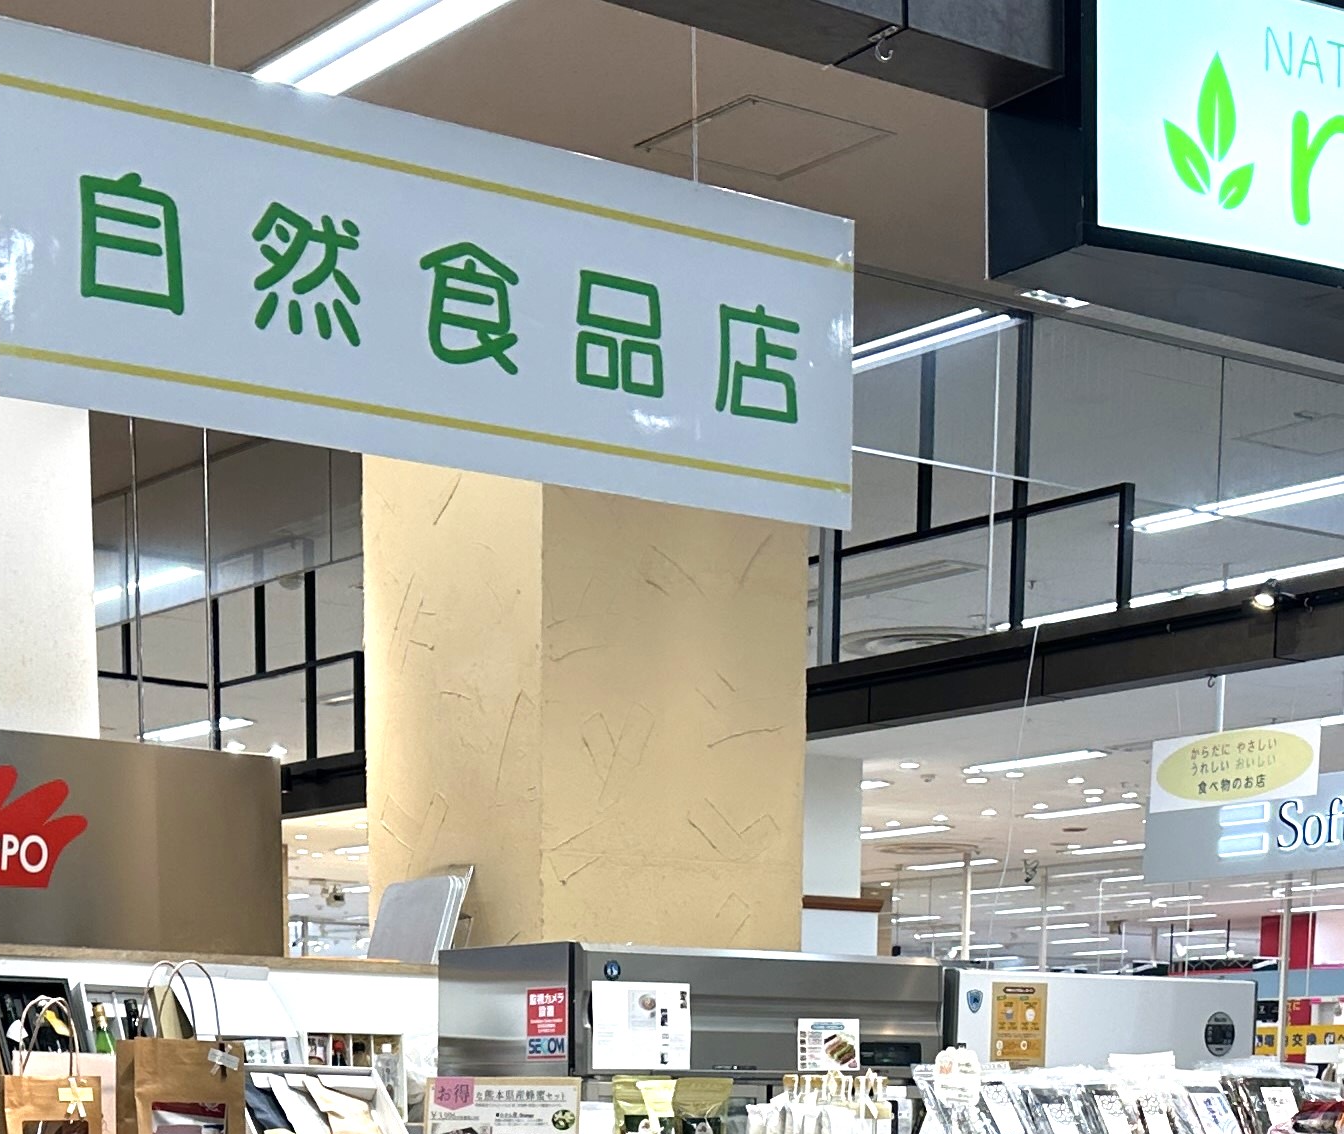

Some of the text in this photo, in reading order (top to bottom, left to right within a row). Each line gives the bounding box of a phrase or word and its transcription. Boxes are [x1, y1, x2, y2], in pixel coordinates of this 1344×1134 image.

[78, 172, 801, 425] 自然食品店
[1198, 772, 1266, 795] 食べ物のお店
[529, 1037, 565, 1055] SECOM
[437, 1083, 471, 1103] お得
